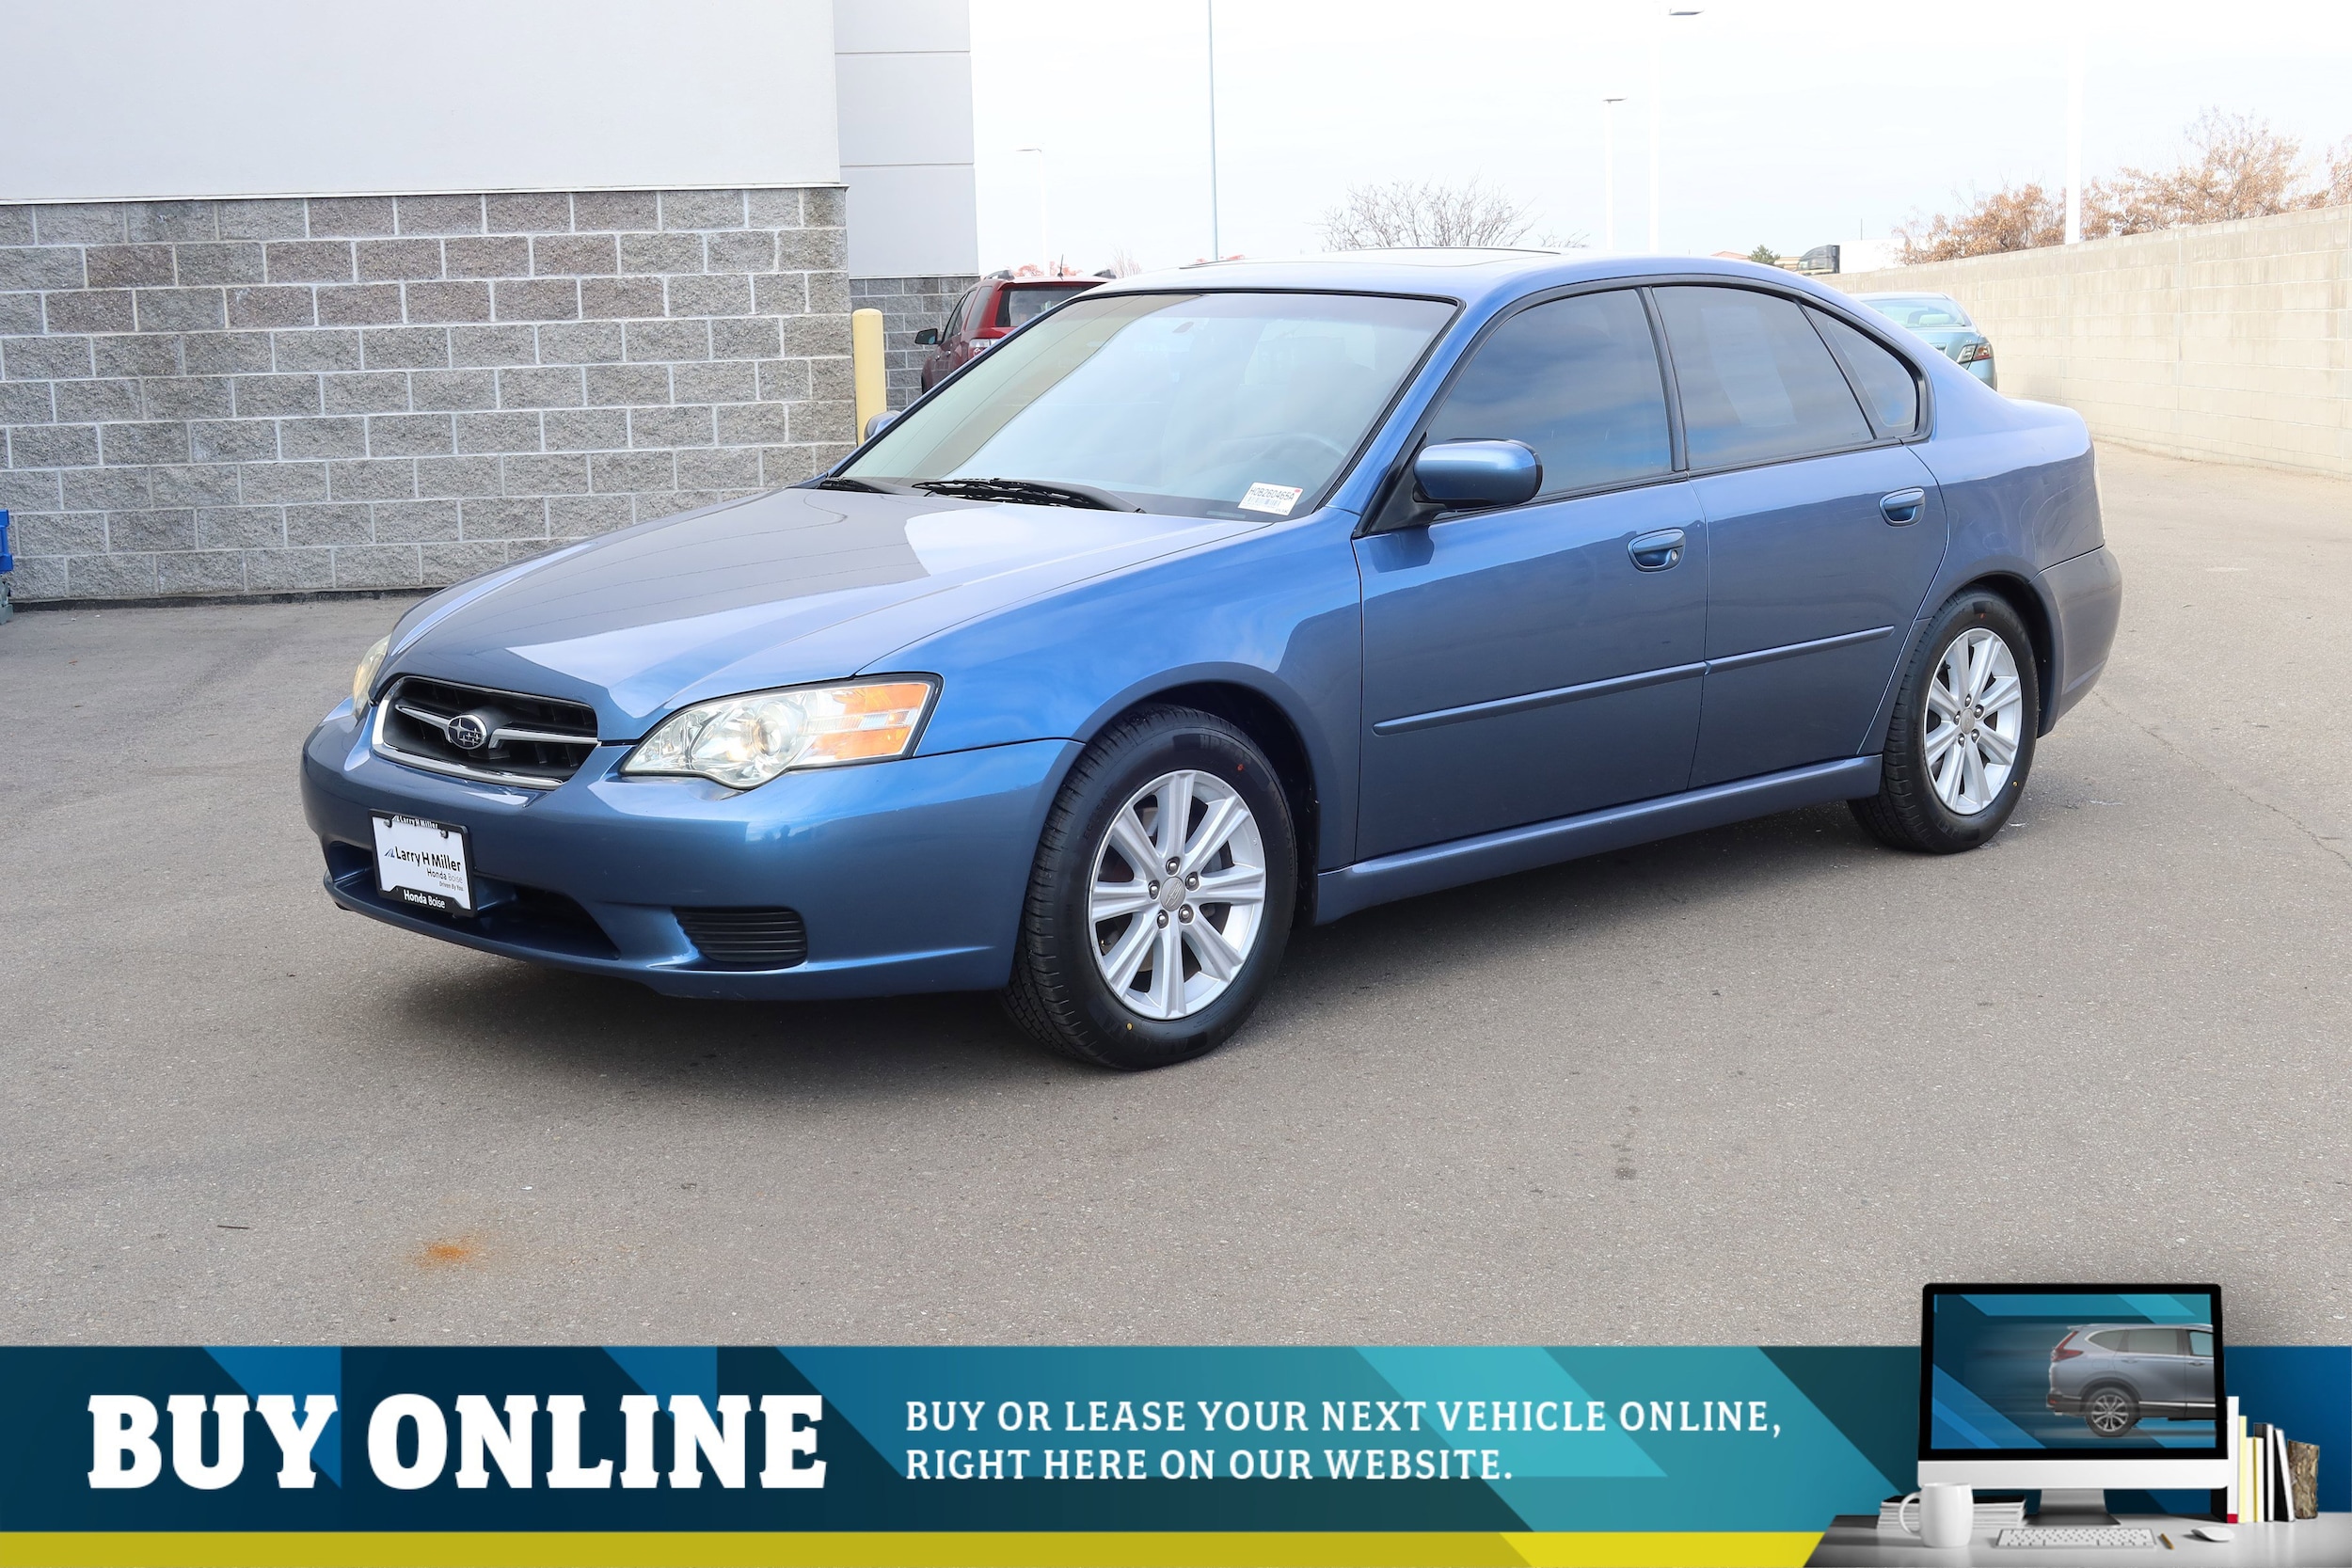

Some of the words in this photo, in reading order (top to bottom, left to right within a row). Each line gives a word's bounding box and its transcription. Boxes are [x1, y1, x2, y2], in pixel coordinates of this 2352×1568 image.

[400, 816, 415, 826] Larry
[421, 819, 438, 829] Miller
[395, 846, 421, 866] Larry
[421, 851, 430, 865] H
[432, 853, 461, 872] Miller
[427, 867, 447, 880] Honda
[448, 873, 463, 884] Boise
[439, 880, 451, 889] Driven
[404, 889, 427, 905] Honda
[428, 895, 446, 909] Boise
